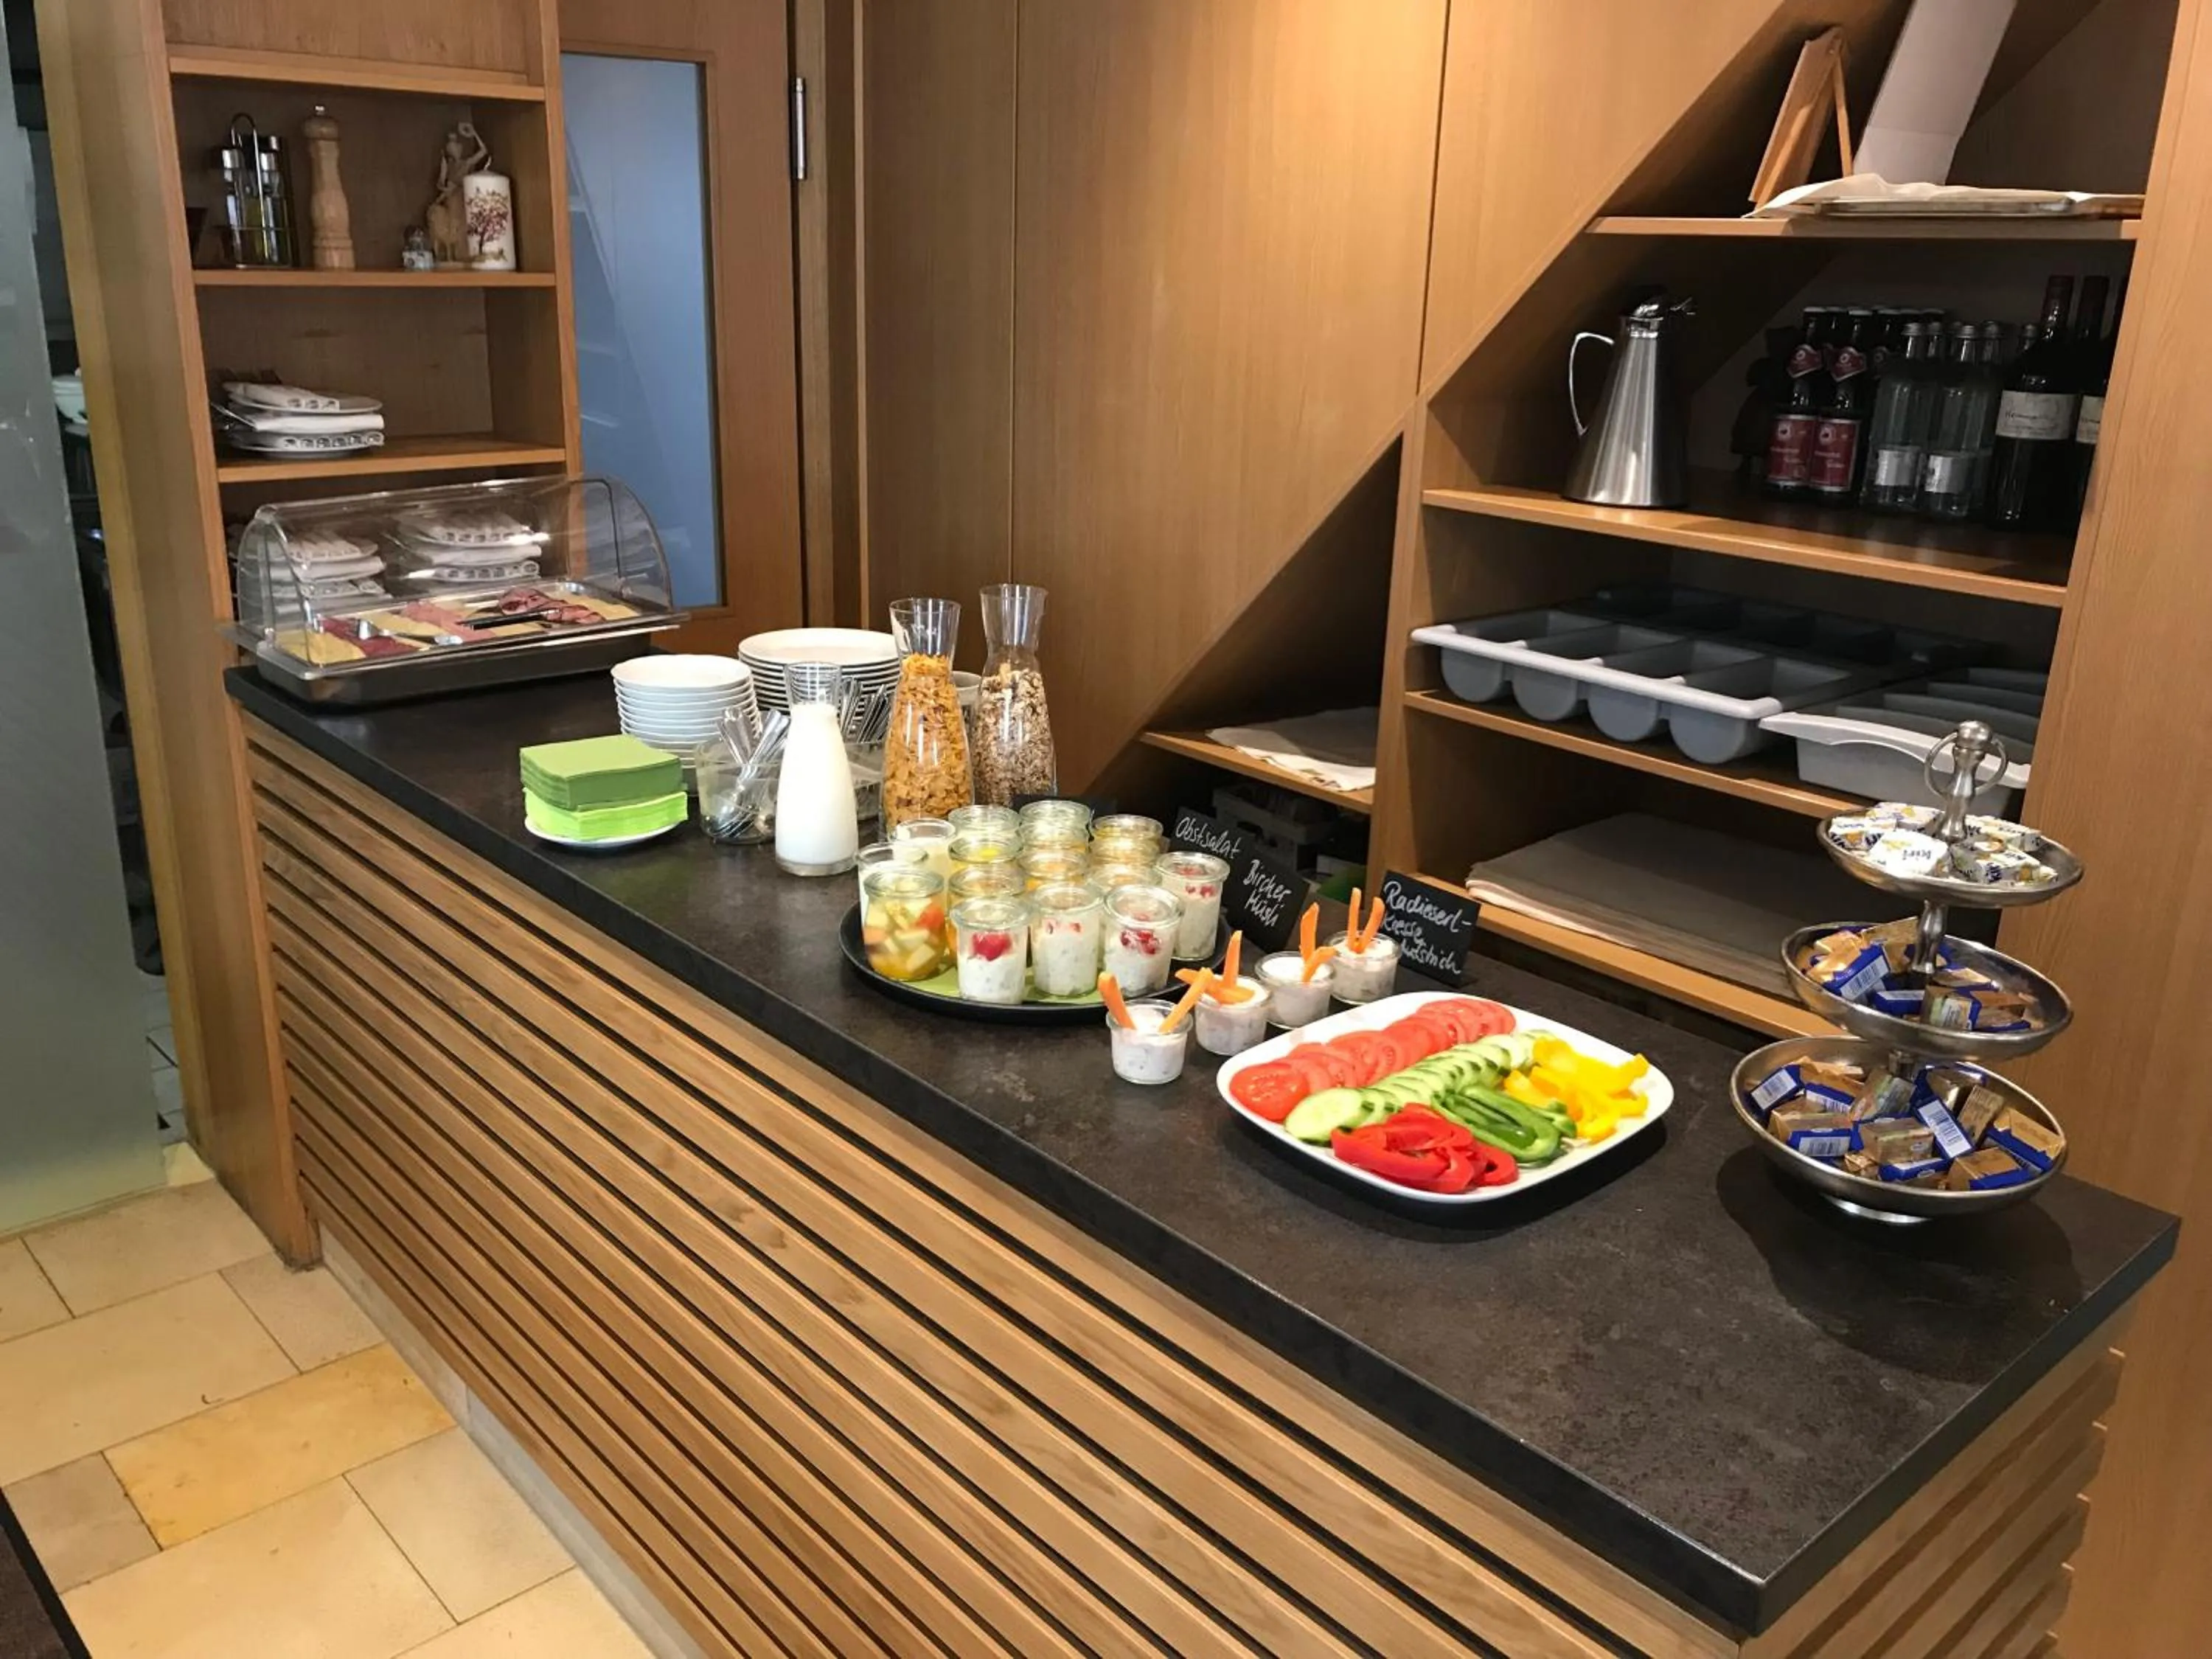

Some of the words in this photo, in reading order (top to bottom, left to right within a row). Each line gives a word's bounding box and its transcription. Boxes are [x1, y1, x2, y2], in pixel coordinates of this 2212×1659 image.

[1175, 816, 1242, 859] Obstsalat
[1242, 859, 1292, 902] Bircher
[1244, 888, 1286, 927] Müsli
